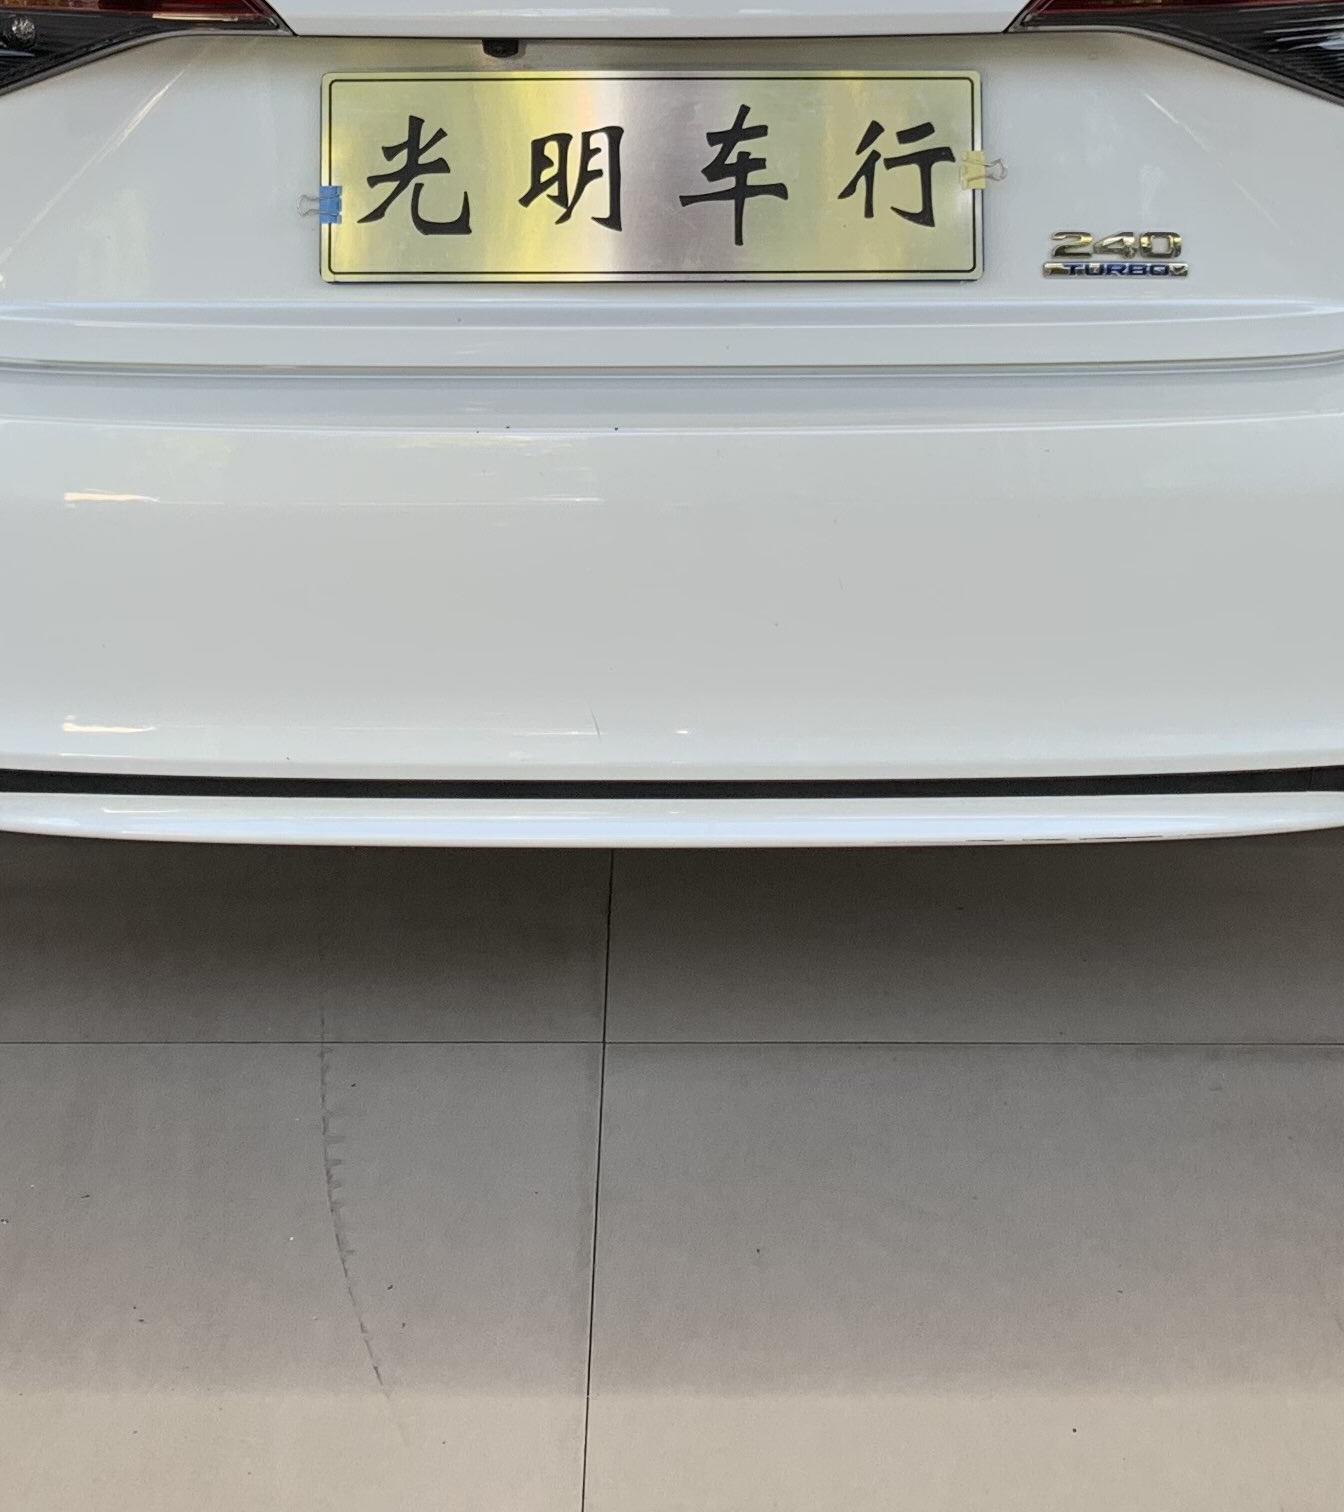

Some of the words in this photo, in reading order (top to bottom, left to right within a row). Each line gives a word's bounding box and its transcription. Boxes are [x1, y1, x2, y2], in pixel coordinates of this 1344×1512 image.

[356, 104, 956, 245] 光明车行
[1052, 231, 1182, 258] 240
[1064, 263, 1170, 276] TURBO
